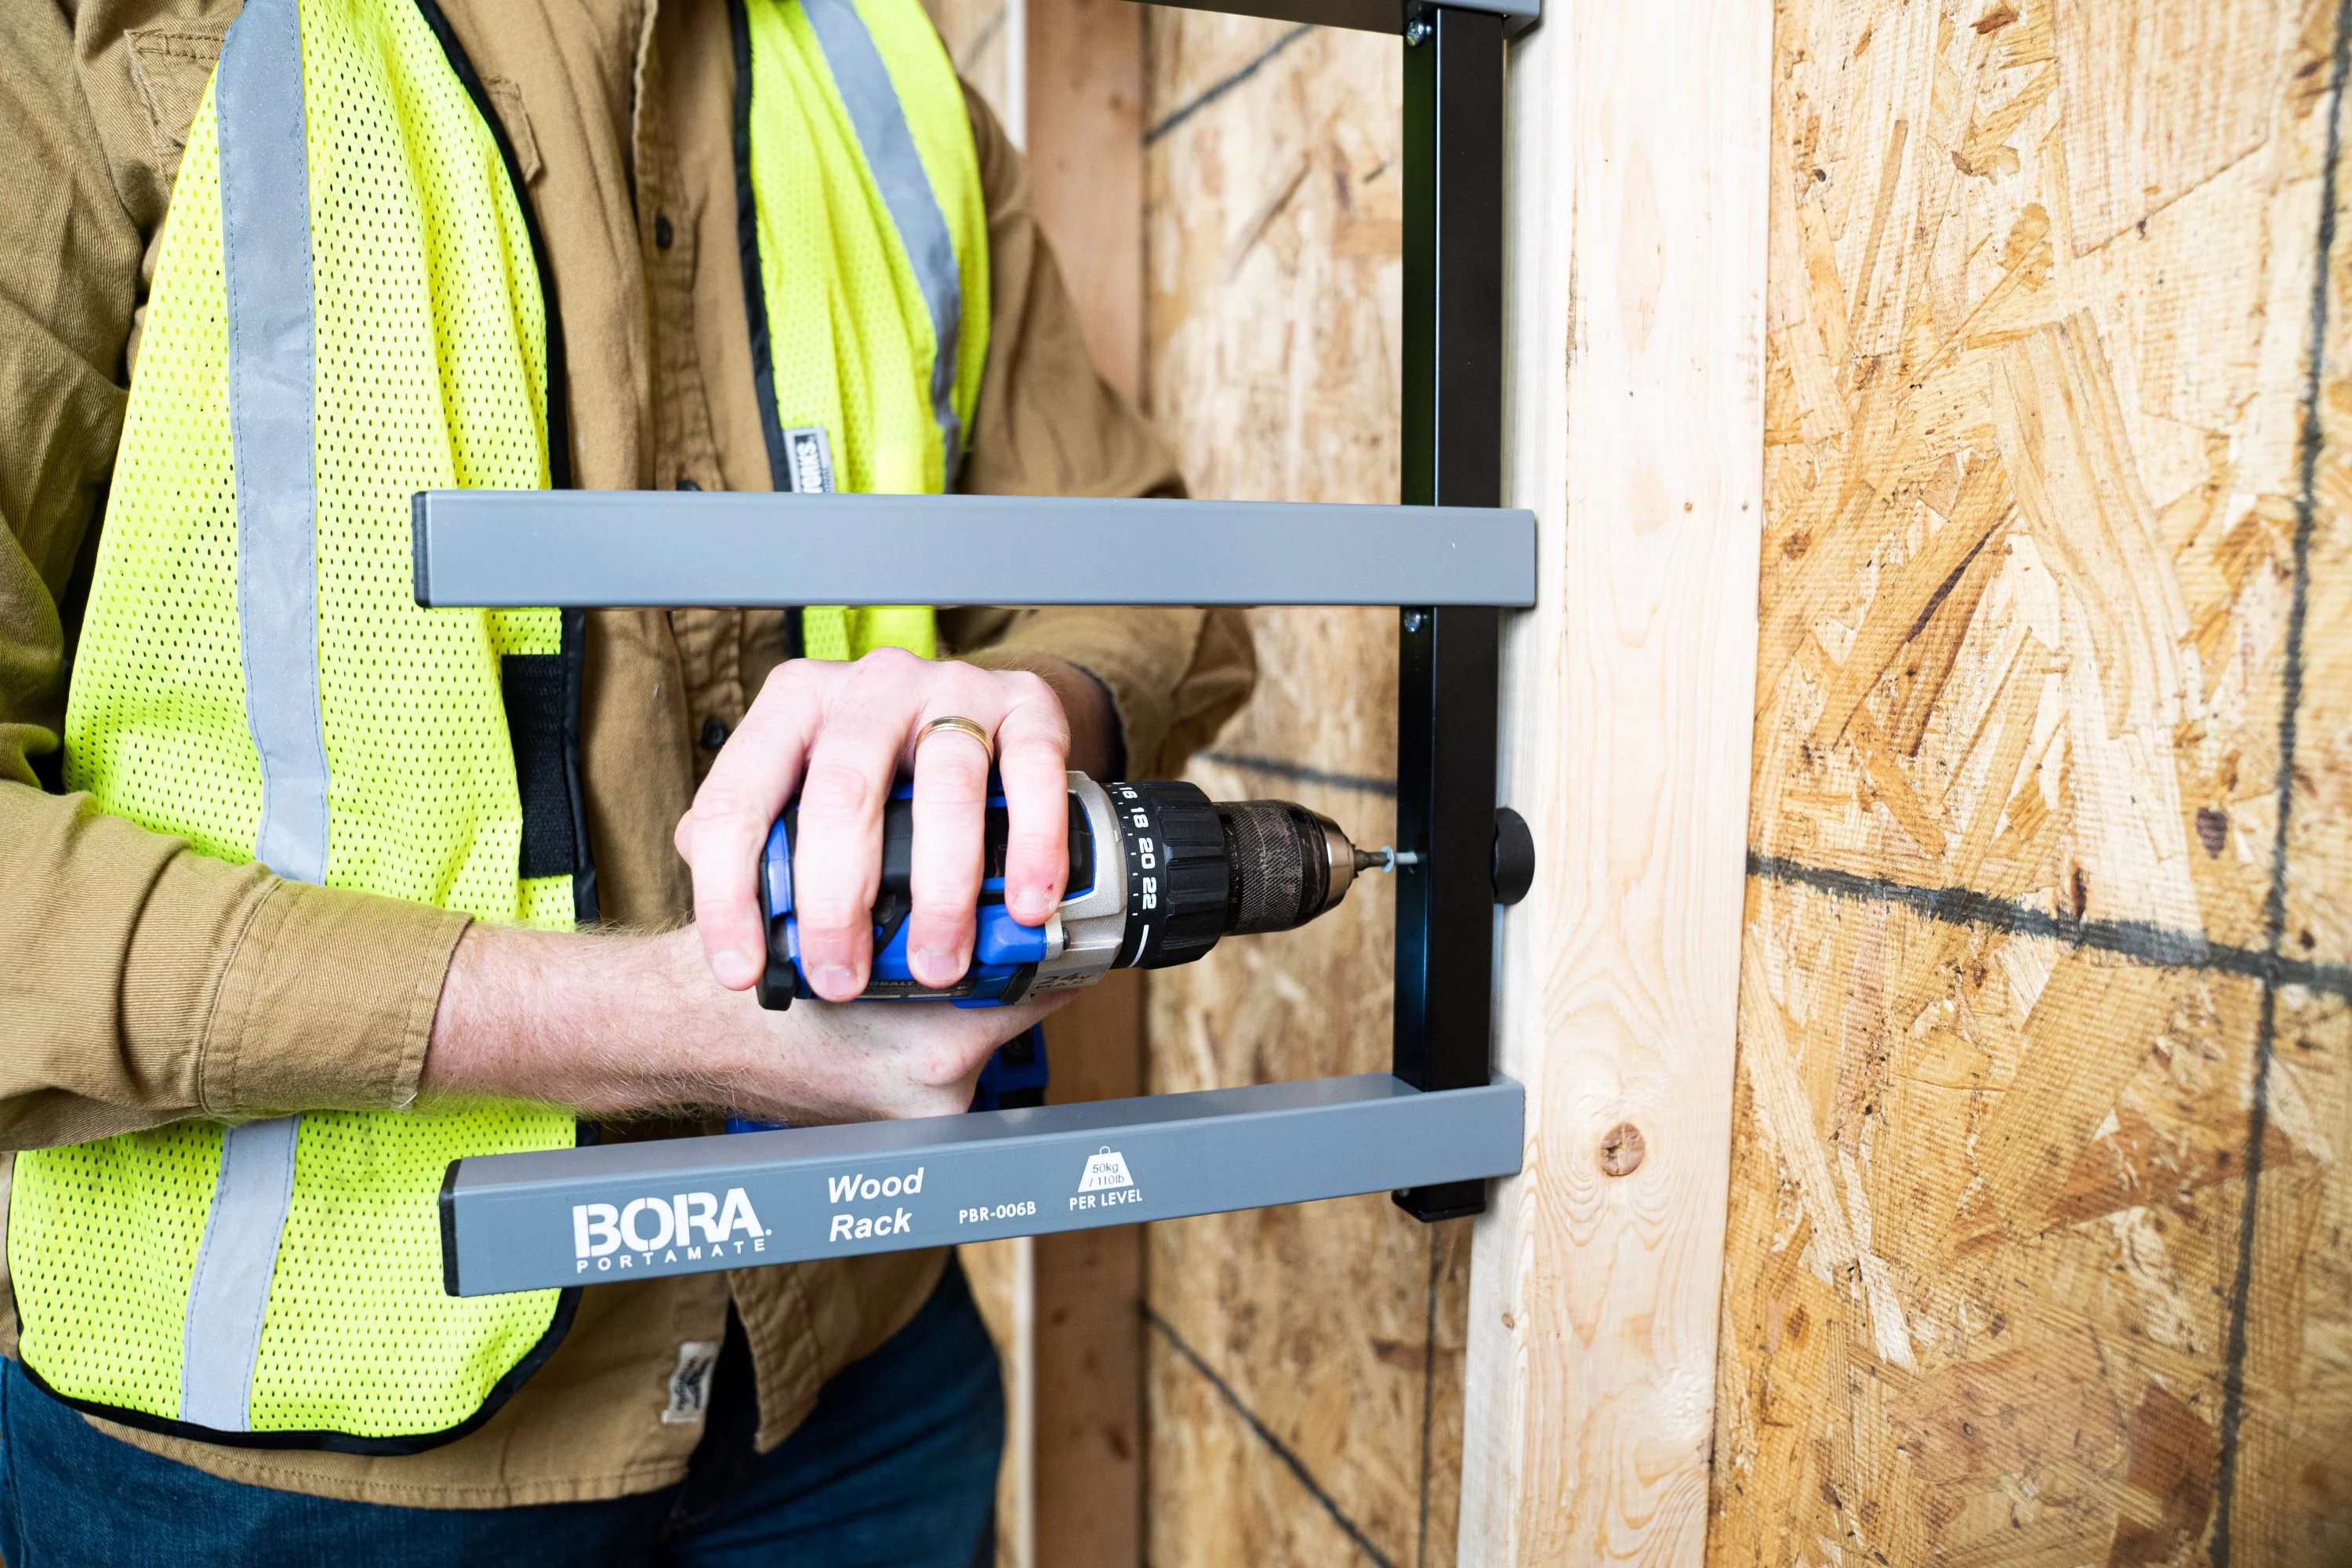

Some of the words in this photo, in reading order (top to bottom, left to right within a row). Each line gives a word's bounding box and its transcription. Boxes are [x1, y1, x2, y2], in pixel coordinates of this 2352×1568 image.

[1119, 786, 1138, 799] 16
[1131, 807, 1149, 829] 18
[1138, 837, 1156, 869] 20
[1142, 877, 1156, 909] 22
[1092, 1163, 1119, 1174] 50kg
[1098, 1174, 1125, 1186] 110lb
[828, 1167, 924, 1203] Wood
[959, 1200, 1036, 1225] PBR-006B
[1069, 1195, 1096, 1211] PER
[1101, 1189, 1143, 1207] LEVEL
[829, 1207, 913, 1242] Rack
[576, 1238, 766, 1274] PORTAMATE
